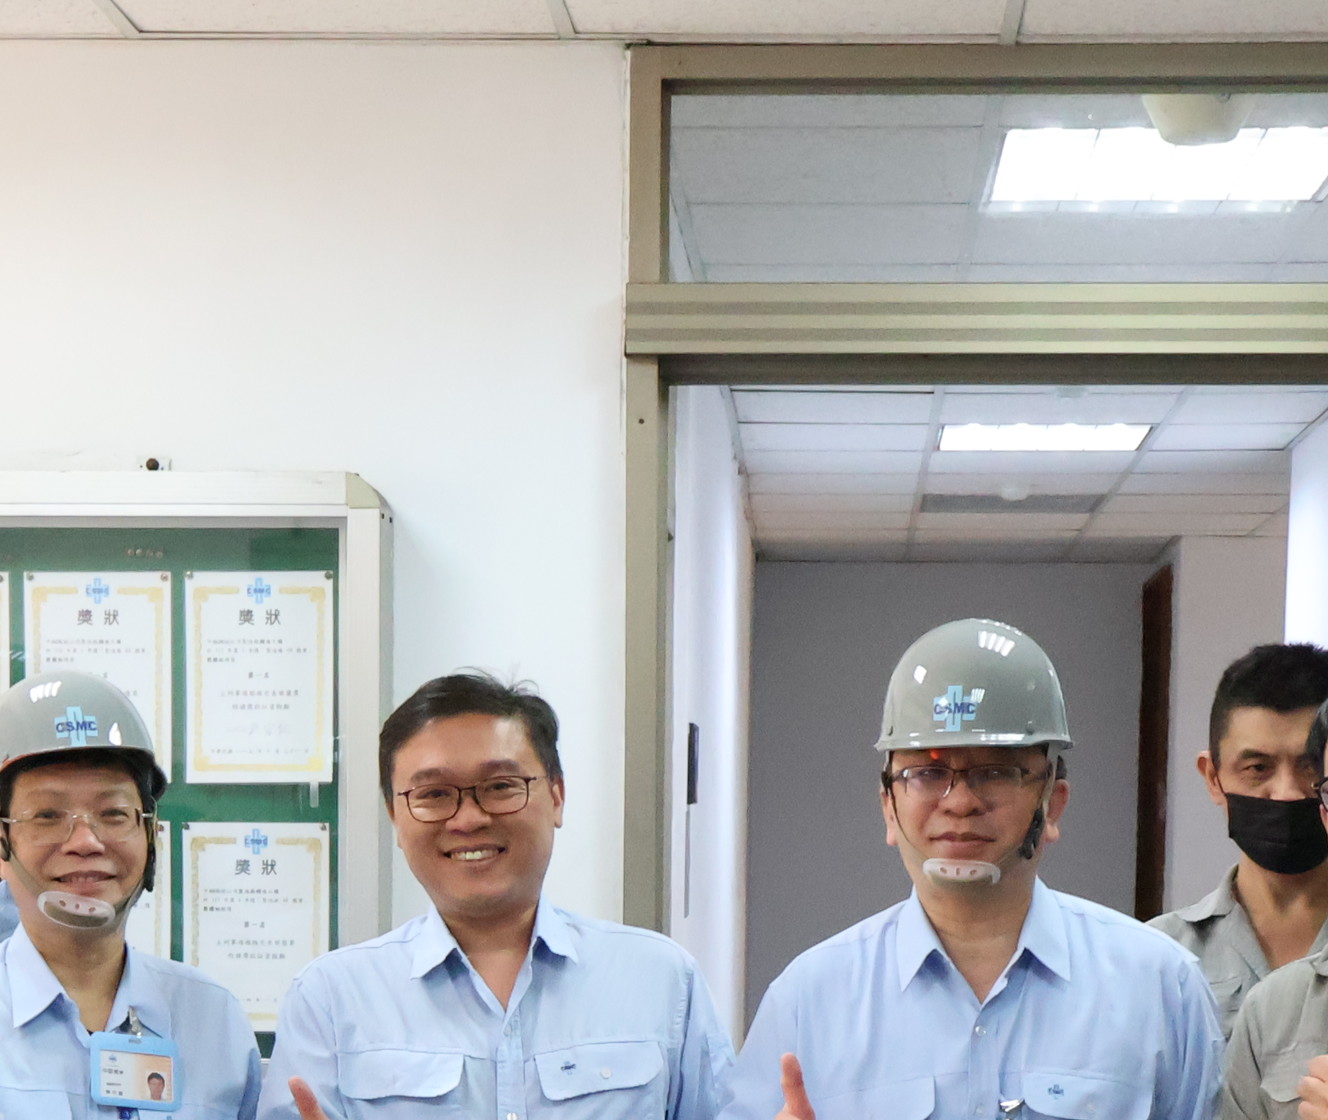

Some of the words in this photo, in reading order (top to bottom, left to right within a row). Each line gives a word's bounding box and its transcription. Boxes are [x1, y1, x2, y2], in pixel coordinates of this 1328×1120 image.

[239, 608, 281, 626] 獎狀
[934, 702, 976, 715] CSMC
[55, 720, 98, 733] CSMC
[235, 859, 277, 876] 獎狀
